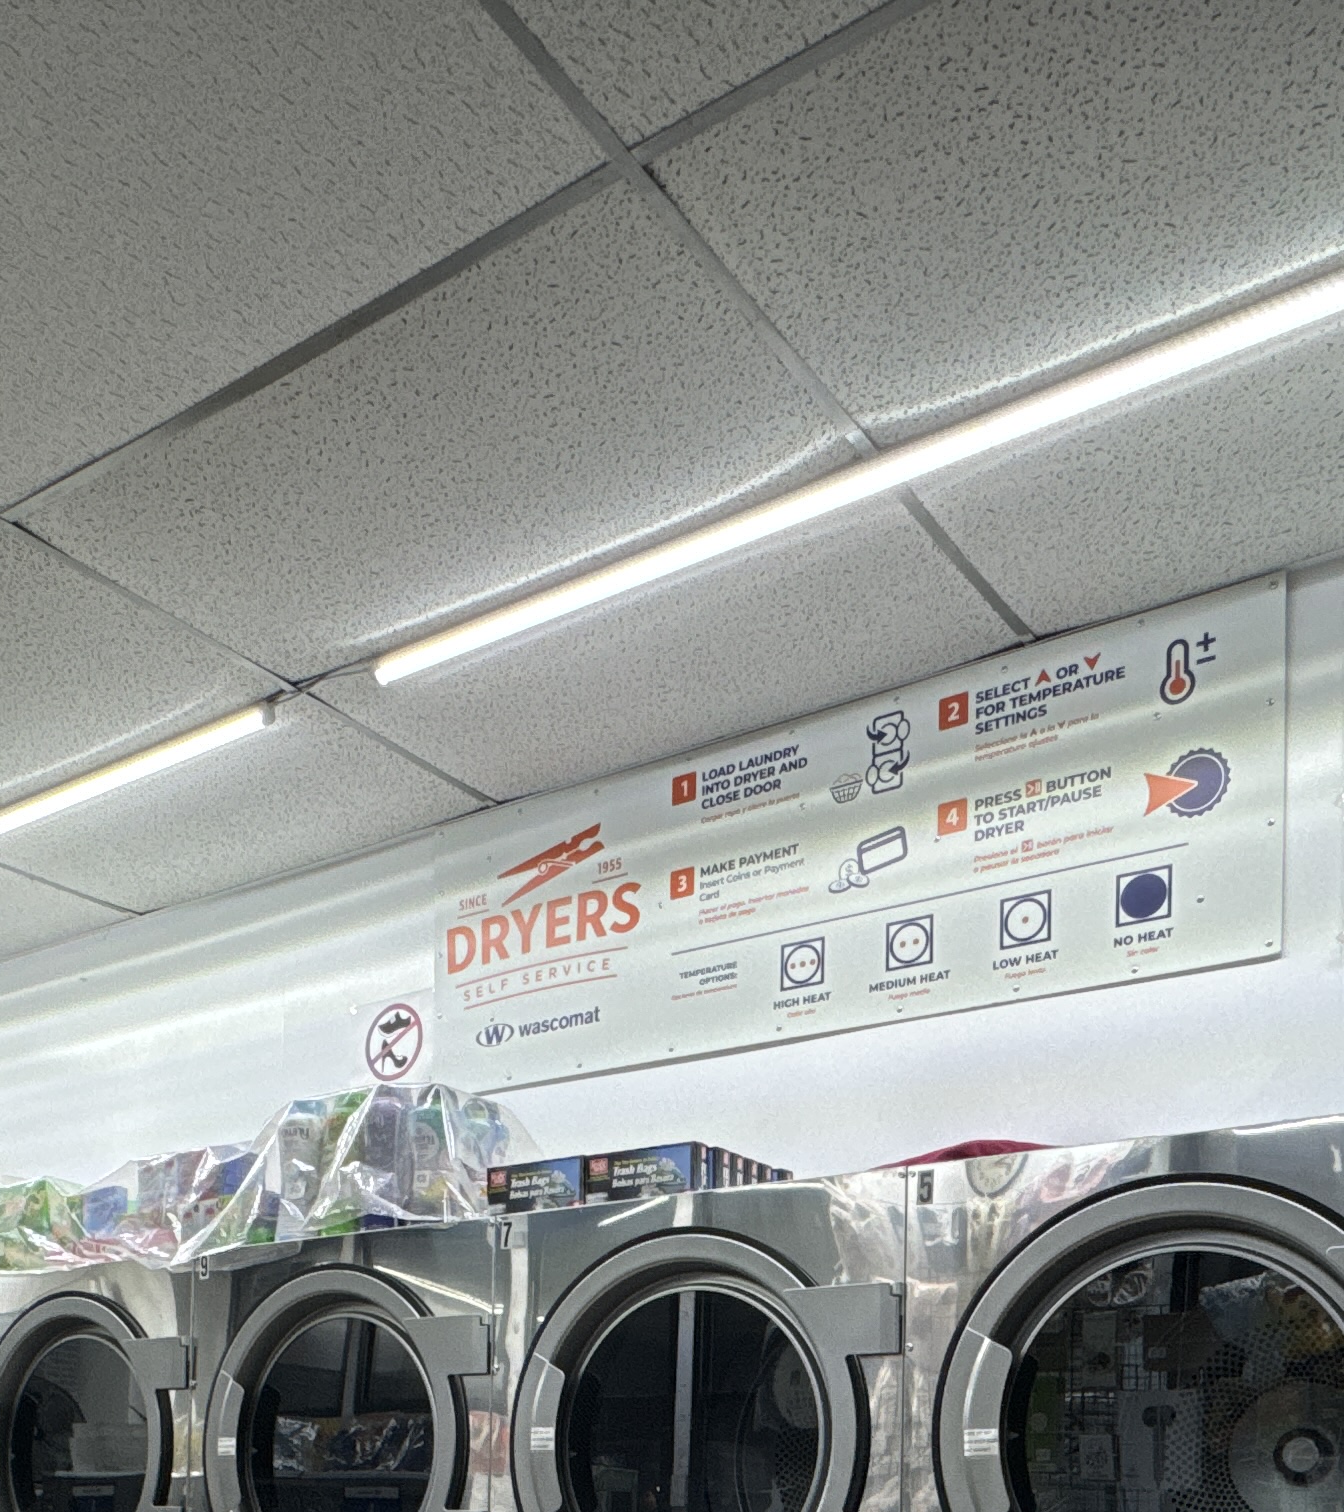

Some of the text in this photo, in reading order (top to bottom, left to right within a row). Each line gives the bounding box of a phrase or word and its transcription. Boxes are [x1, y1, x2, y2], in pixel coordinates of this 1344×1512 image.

[975, 663, 1079, 704] SELECT OR
[975, 665, 1126, 720] FOR TEMPERATURE
[947, 701, 960, 723] 2
[974, 704, 1048, 735] SETTINGS
[702, 744, 800, 782] LOAD LAUNDRY
[702, 757, 808, 796] INTO DRYER AND
[680, 780, 689, 797] 1
[701, 778, 782, 810] CLOSE DOOR
[974, 766, 1112, 812] PRESS BUTTON
[974, 785, 1103, 826] TO START/PAUSE
[945, 807, 959, 827] 4
[974, 820, 1024, 842] DRYER
[597, 857, 622, 875] 1955
[700, 843, 800, 877] MAKE PAYMENT
[677, 875, 687, 892] 3
[699, 857, 805, 891] Insert Coins or Payment
[459, 893, 487, 911] SINCE
[699, 889, 720, 902] Card
[446, 882, 642, 975] DRYERS
[1114, 927, 1174, 948] NO HEAT
[679, 961, 738, 980] TEMPERATURE
[992, 949, 1059, 971] LOW HEAT
[463, 958, 611, 1002] SELF SERVICE
[699, 973, 738, 986] OPTIONS:
[869, 969, 951, 993] MEDIUM HEAT
[773, 991, 832, 1010] HIGH HEAT
[518, 1006, 601, 1038] wascomat
[613, 1165, 635, 1177] Trash
[636, 1162, 657, 1176] Bags
[510, 1177, 530, 1189] Trash
[531, 1174, 550, 1188] Bags
[634, 1175, 650, 1187] para
[920, 1172, 932, 1202] 5
[529, 1188, 543, 1199] para
[504, 1222, 512, 1247] 7
[201, 1256, 207, 1276] 9
